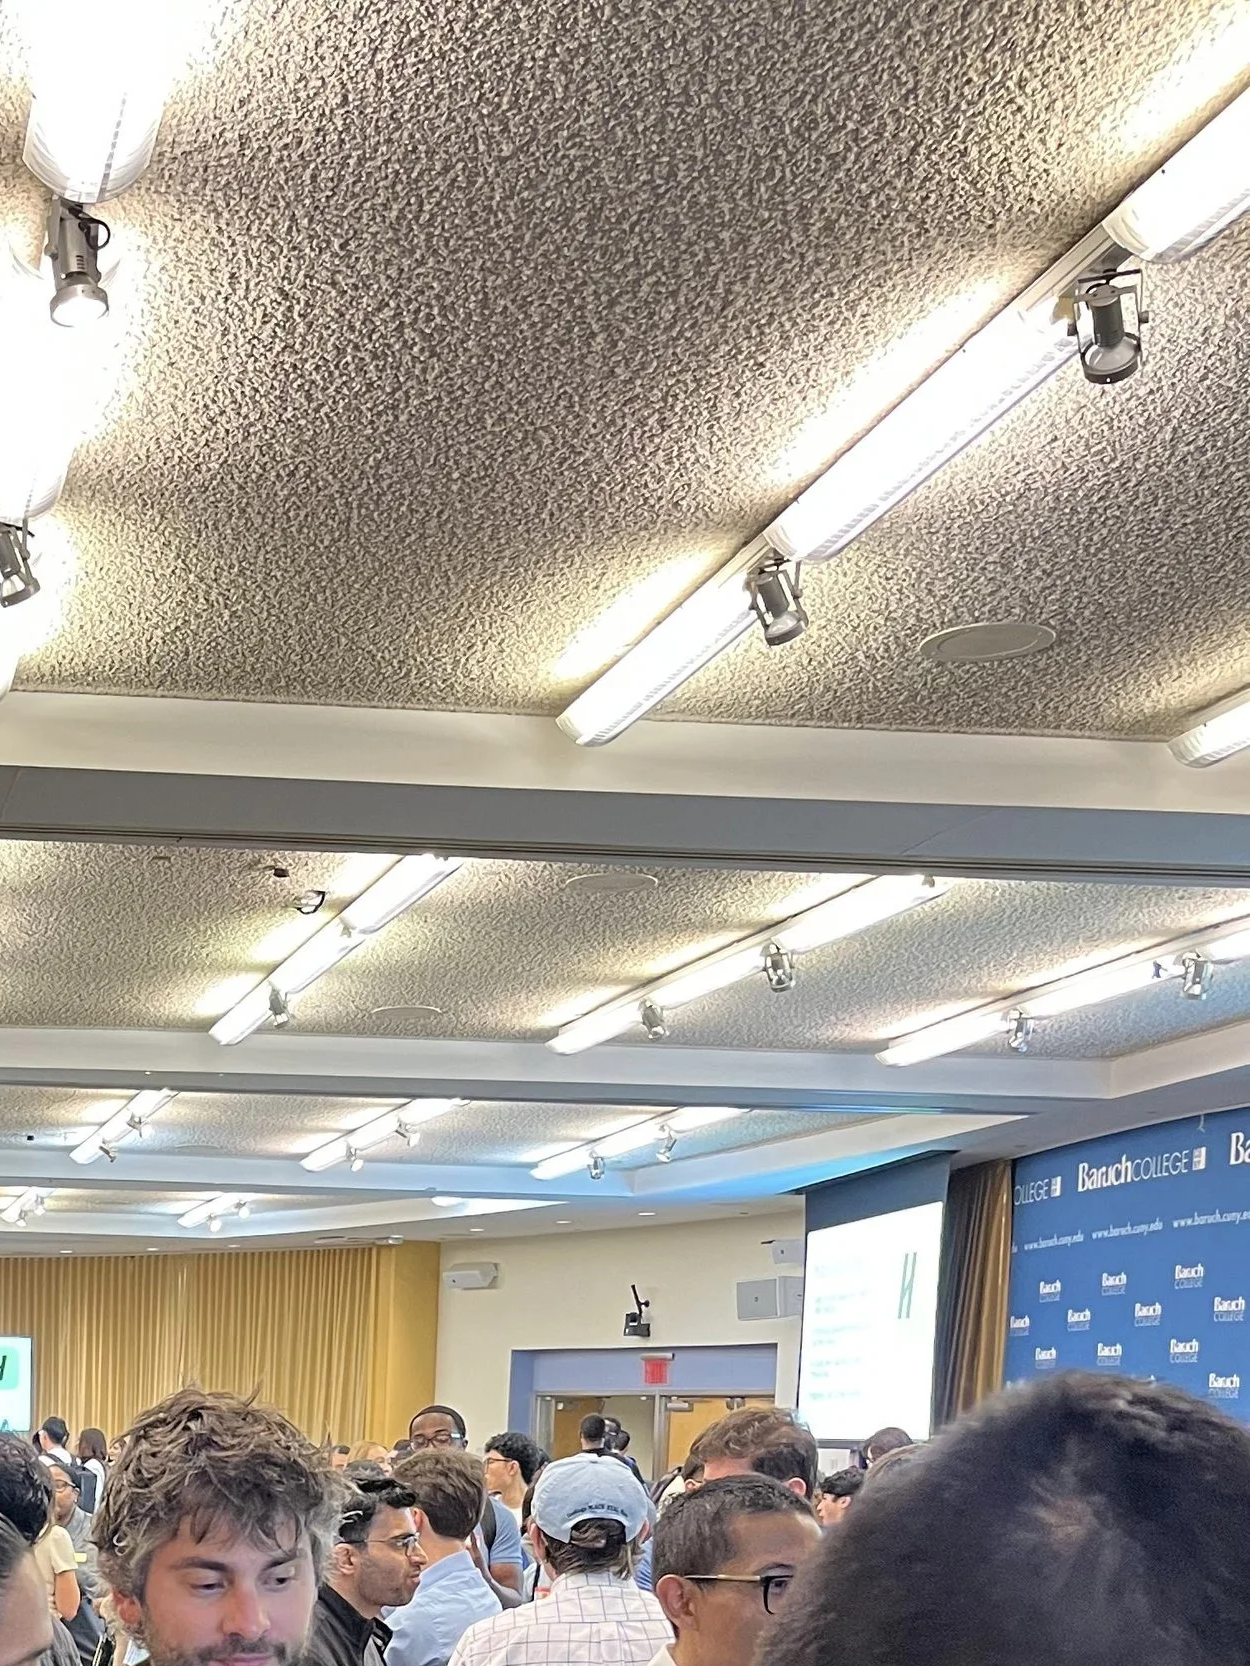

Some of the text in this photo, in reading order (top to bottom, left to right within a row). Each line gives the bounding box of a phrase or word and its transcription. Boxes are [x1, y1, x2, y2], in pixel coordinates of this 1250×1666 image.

[1174, 1263, 1204, 1279] Baruch
[1102, 1272, 1126, 1287] Baruch
[1135, 1302, 1162, 1317] Baruch
[1214, 1296, 1245, 1312] Baruch
[1170, 1338, 1199, 1353] Baruch
[1209, 1373, 1240, 1388] Baruch
